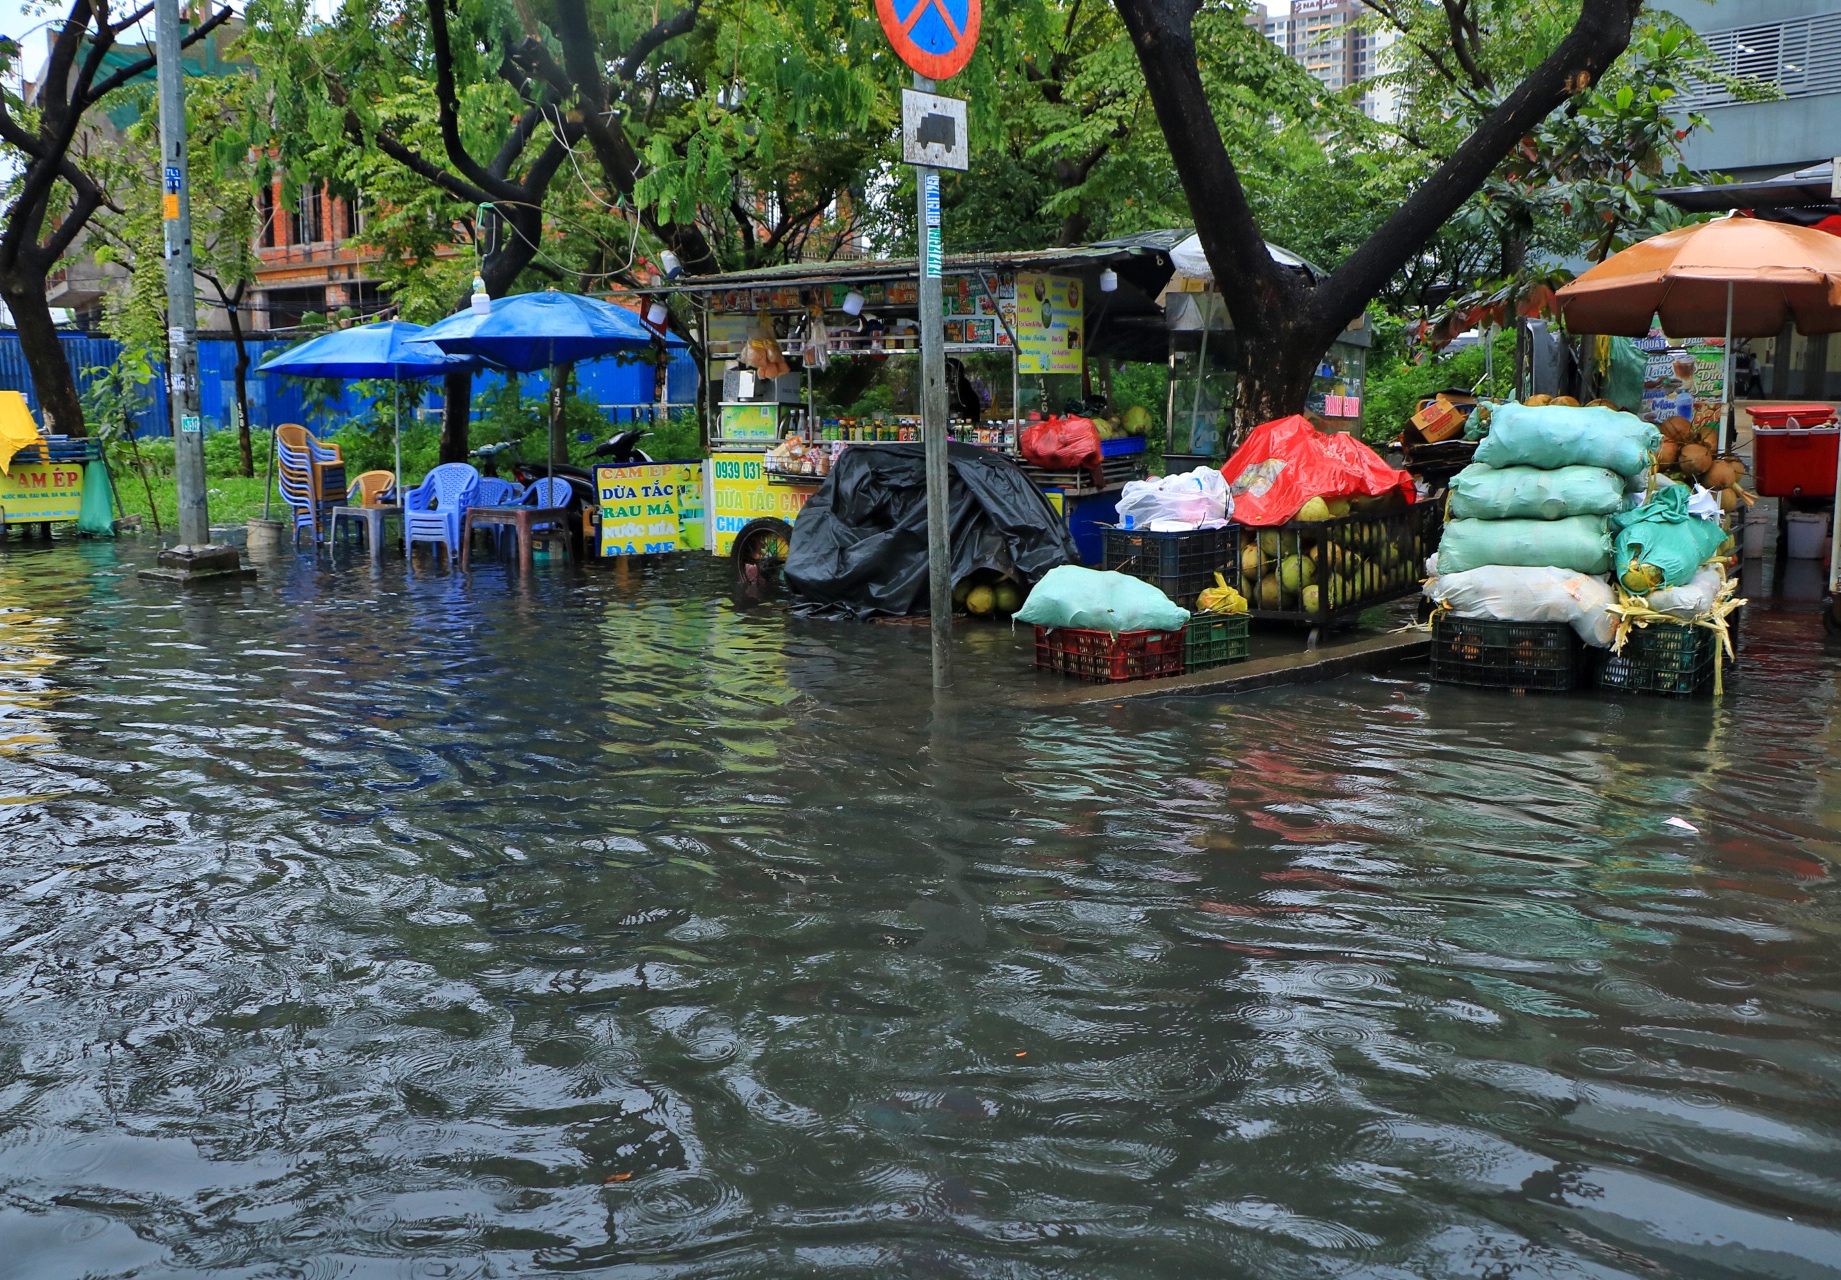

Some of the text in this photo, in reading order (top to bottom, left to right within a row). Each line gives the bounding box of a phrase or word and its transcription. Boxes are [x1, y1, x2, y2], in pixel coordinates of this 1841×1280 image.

[1647, 356, 1673, 364] acao
[1039, 378, 1048, 413] 156
[53, 467, 78, 488] ÉP
[601, 466, 643, 480] CAM
[715, 462, 740, 479] 0939
[743, 462, 761, 479] 031
[602, 480, 674, 500] DỪA TẮC
[715, 486, 743, 510] DỪA
[747, 485, 775, 512] TẮC
[602, 500, 675, 519] RAU MÁ
[603, 520, 676, 539] NƯỚC MÍA
